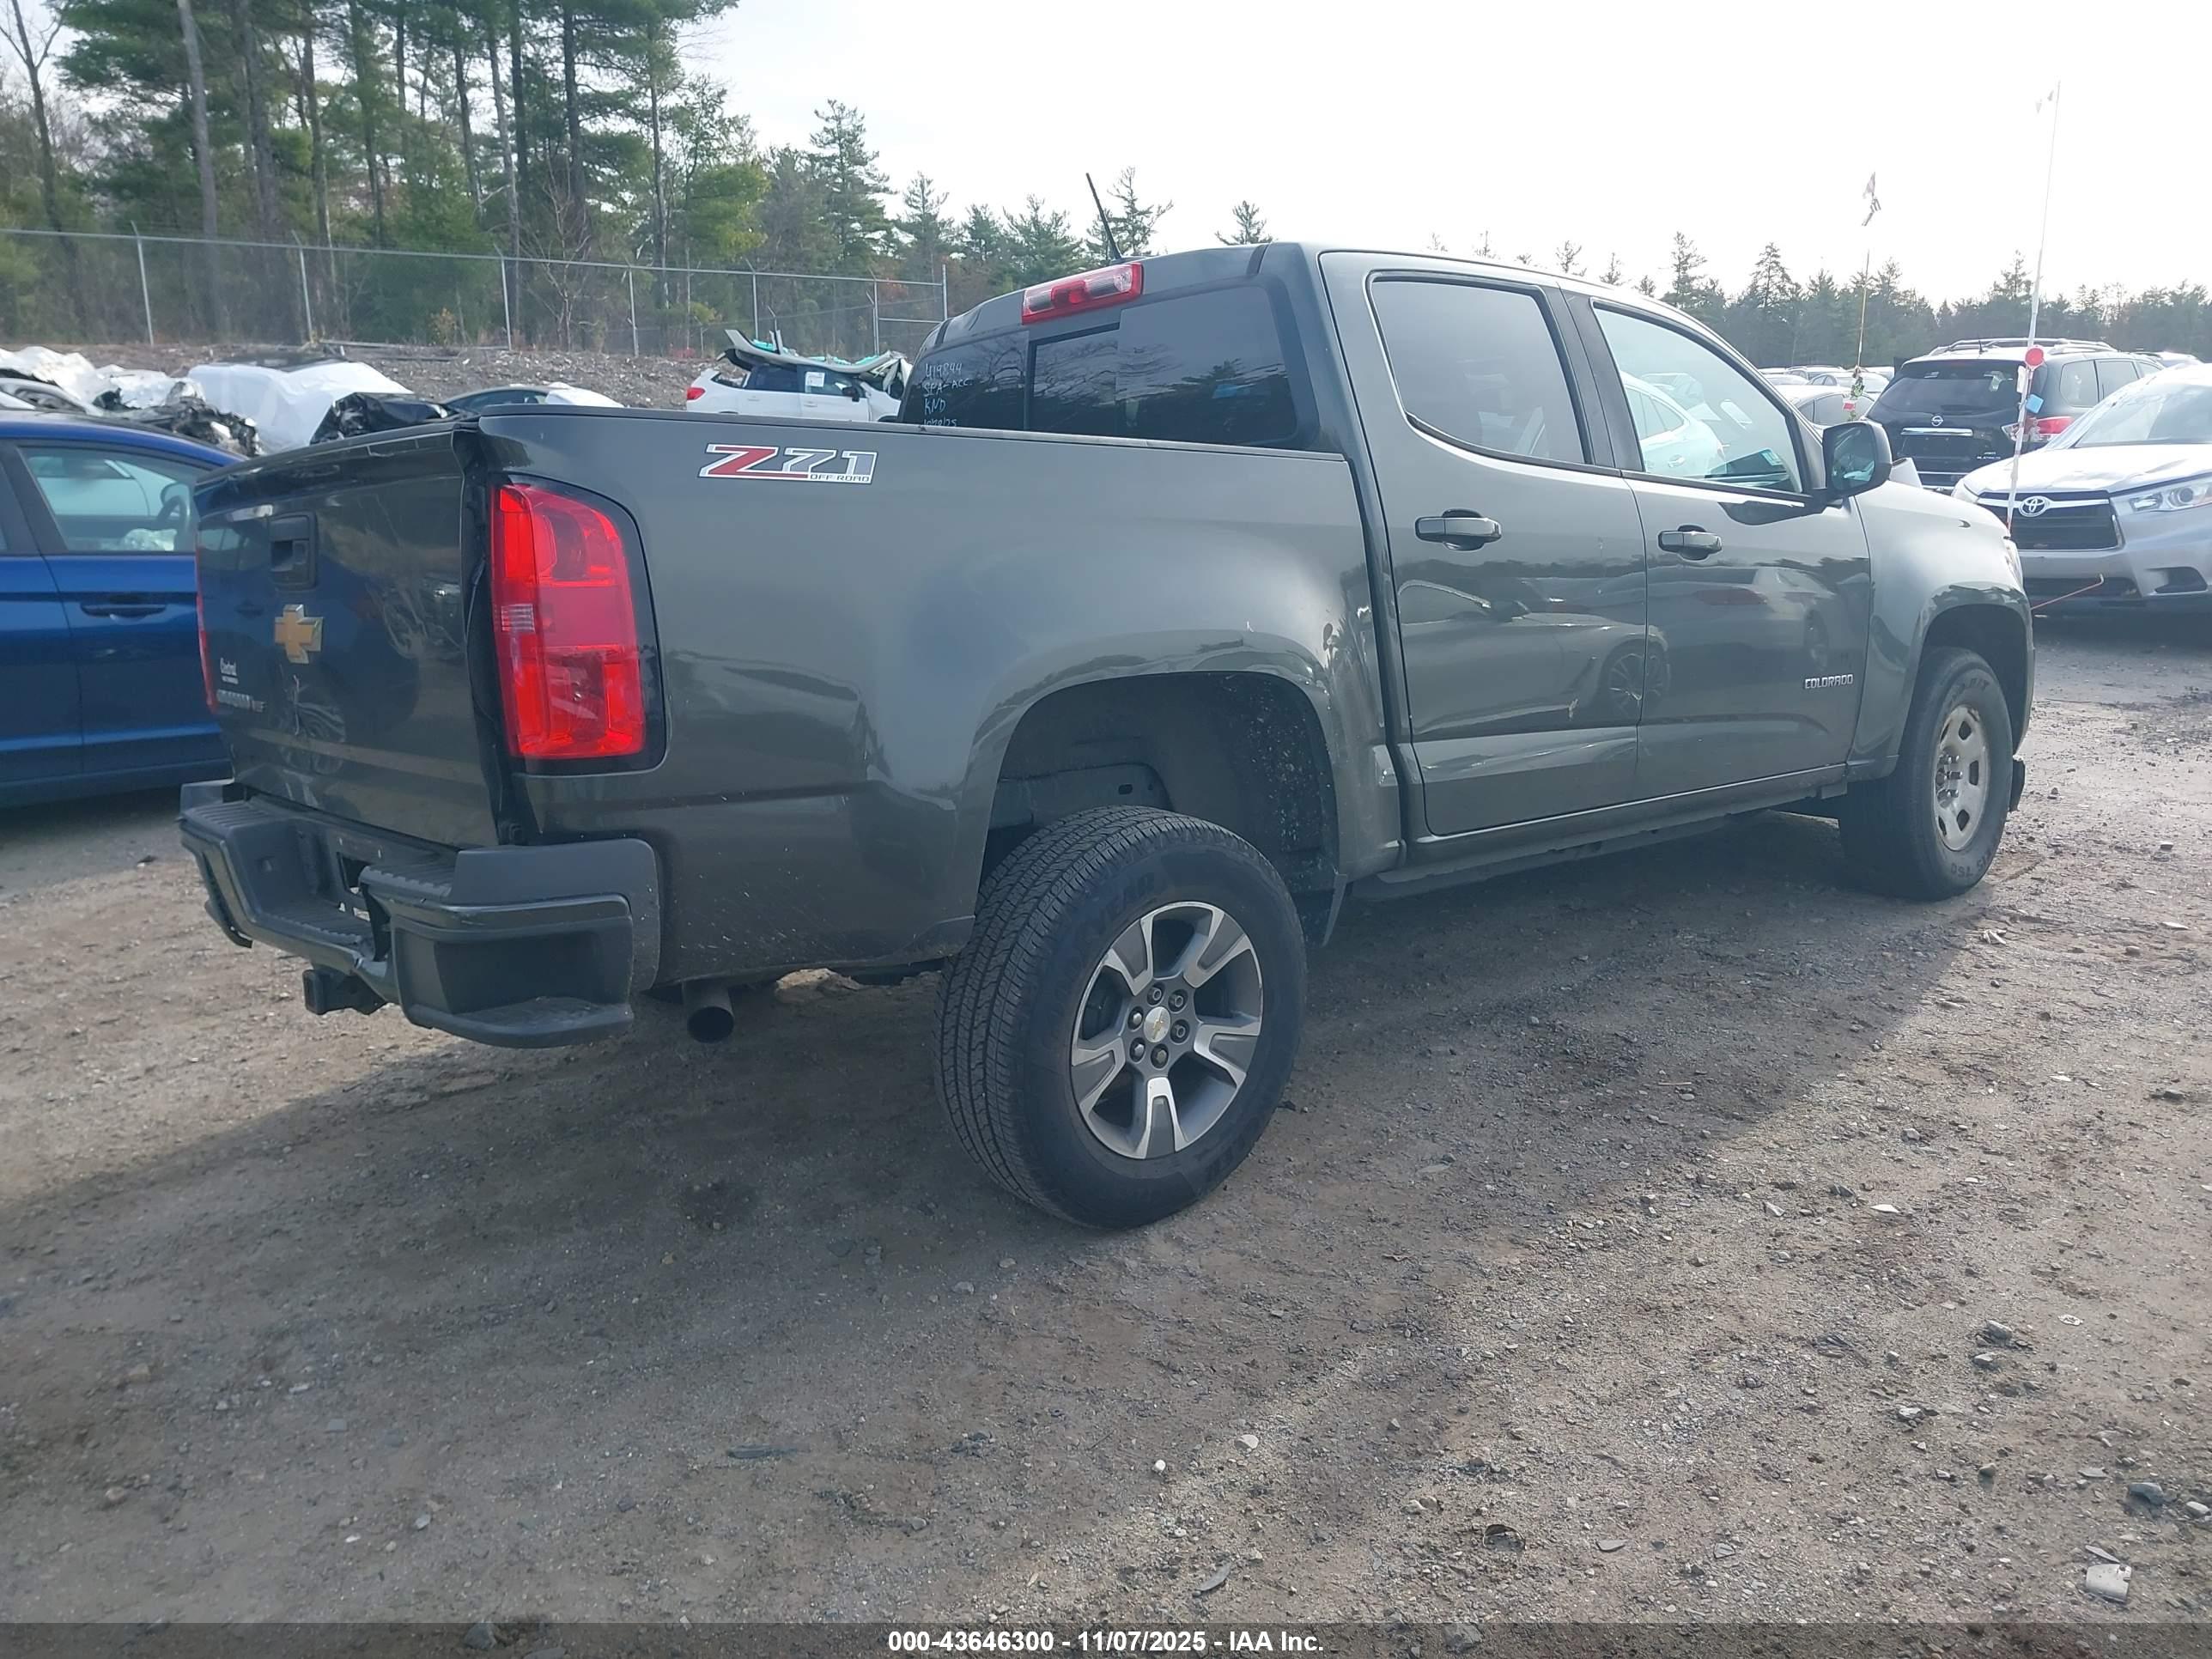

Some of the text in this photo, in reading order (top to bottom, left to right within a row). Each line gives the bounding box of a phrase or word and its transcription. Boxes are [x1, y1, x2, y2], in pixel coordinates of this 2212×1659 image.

[699, 444, 878, 482] Z71
[836, 474, 870, 483] ROAD
[1805, 674, 1853, 689] COLORADO
